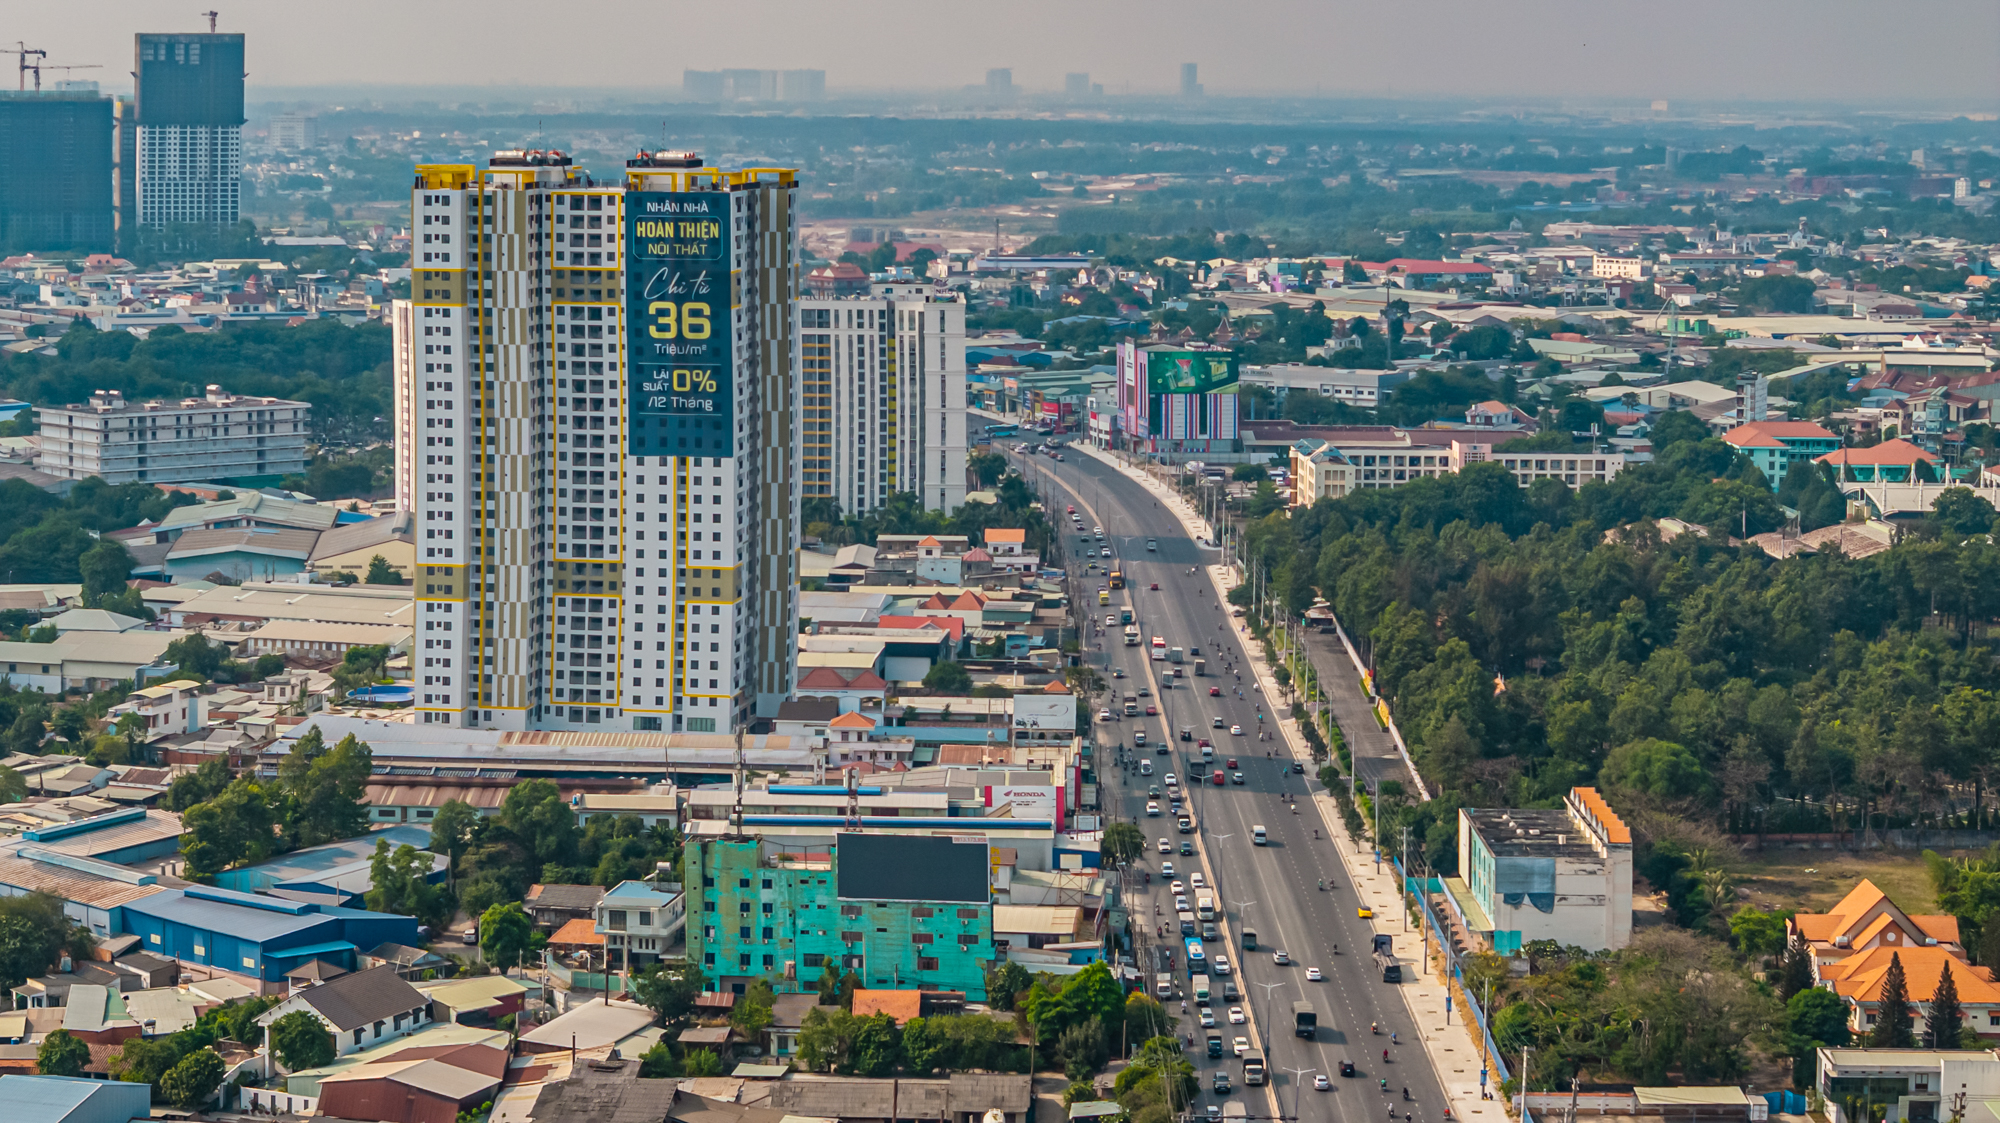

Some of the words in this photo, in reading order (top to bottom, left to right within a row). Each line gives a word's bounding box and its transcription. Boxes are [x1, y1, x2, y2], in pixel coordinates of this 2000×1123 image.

[646, 200, 680, 214] NHẬN
[683, 200, 709, 213] NHÀ
[636, 219, 674, 238] HOÀN
[678, 220, 719, 240] THIỆN
[648, 241, 670, 256] NỘI
[673, 240, 708, 255] THẤT
[648, 301, 712, 339] 36
[653, 369, 669, 379] LÃI
[672, 369, 717, 392] 0%
[643, 380, 669, 391] SUẤT
[648, 396, 667, 408] /12
[670, 396, 713, 411] Tháng
